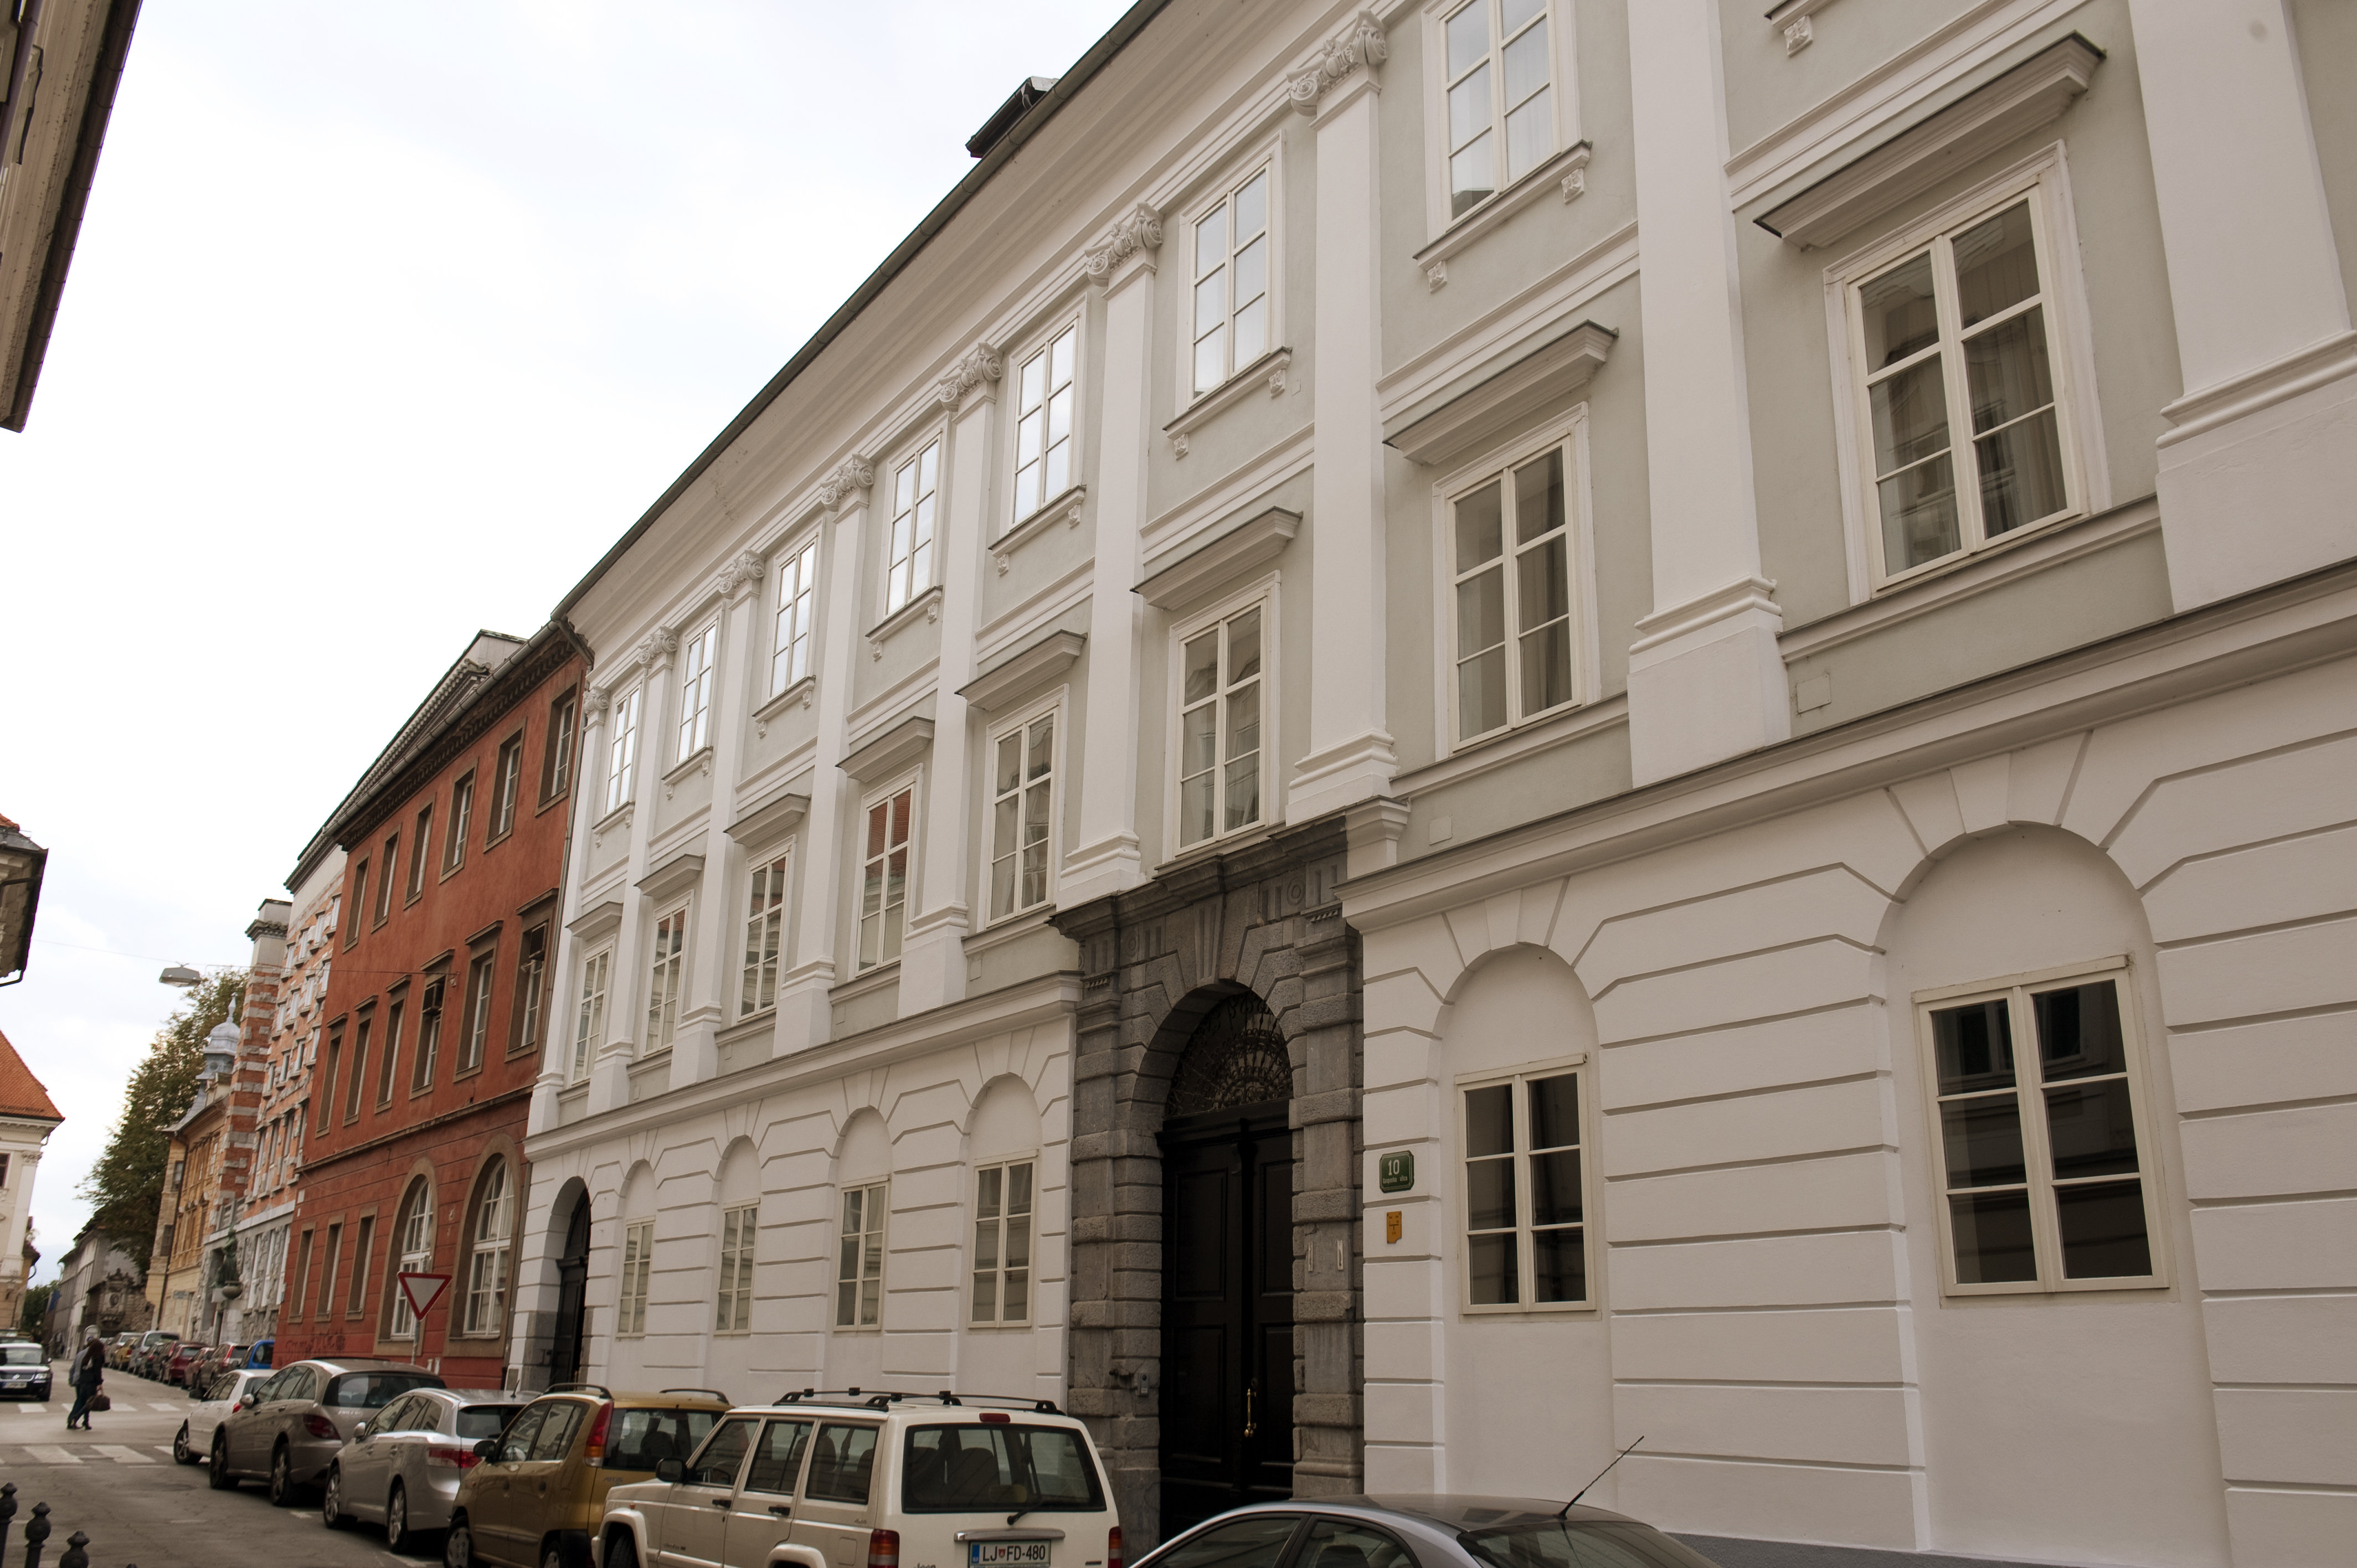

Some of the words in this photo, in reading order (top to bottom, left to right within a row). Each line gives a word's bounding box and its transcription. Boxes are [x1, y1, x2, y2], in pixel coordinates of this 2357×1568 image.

[1388, 1159, 1399, 1175] 10
[982, 1546, 997, 1561] LJ
[1006, 1545, 1046, 1561] FD-480
